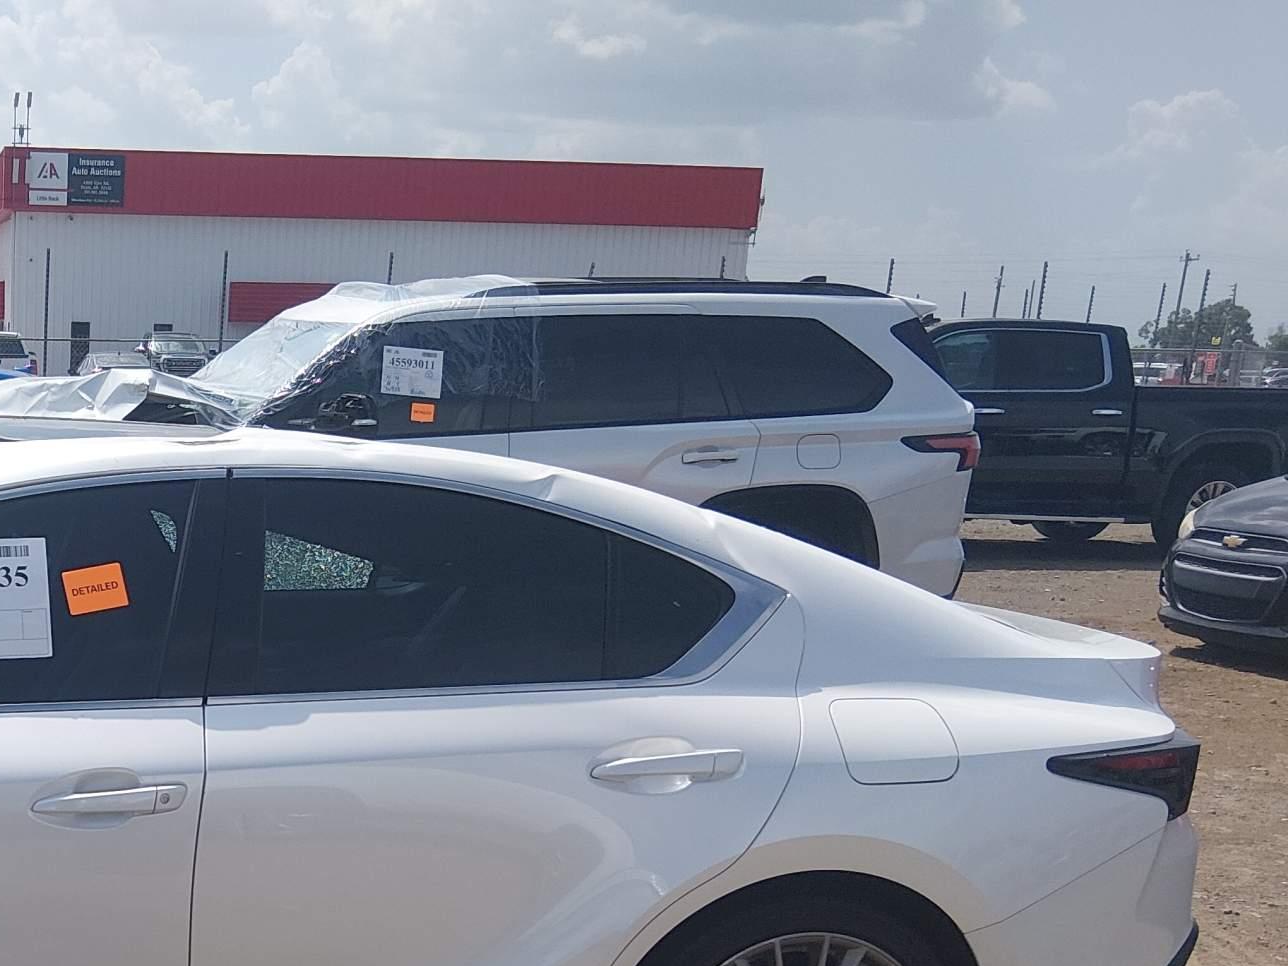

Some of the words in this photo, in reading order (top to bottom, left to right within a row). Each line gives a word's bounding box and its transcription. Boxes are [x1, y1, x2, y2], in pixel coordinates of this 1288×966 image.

[79, 158, 114, 166] Insurance
[72, 167, 88, 175] Auto
[90, 167, 121, 176] Auctions
[389, 357, 435, 370] 45593011
[71, 580, 119, 597] DETAILED
